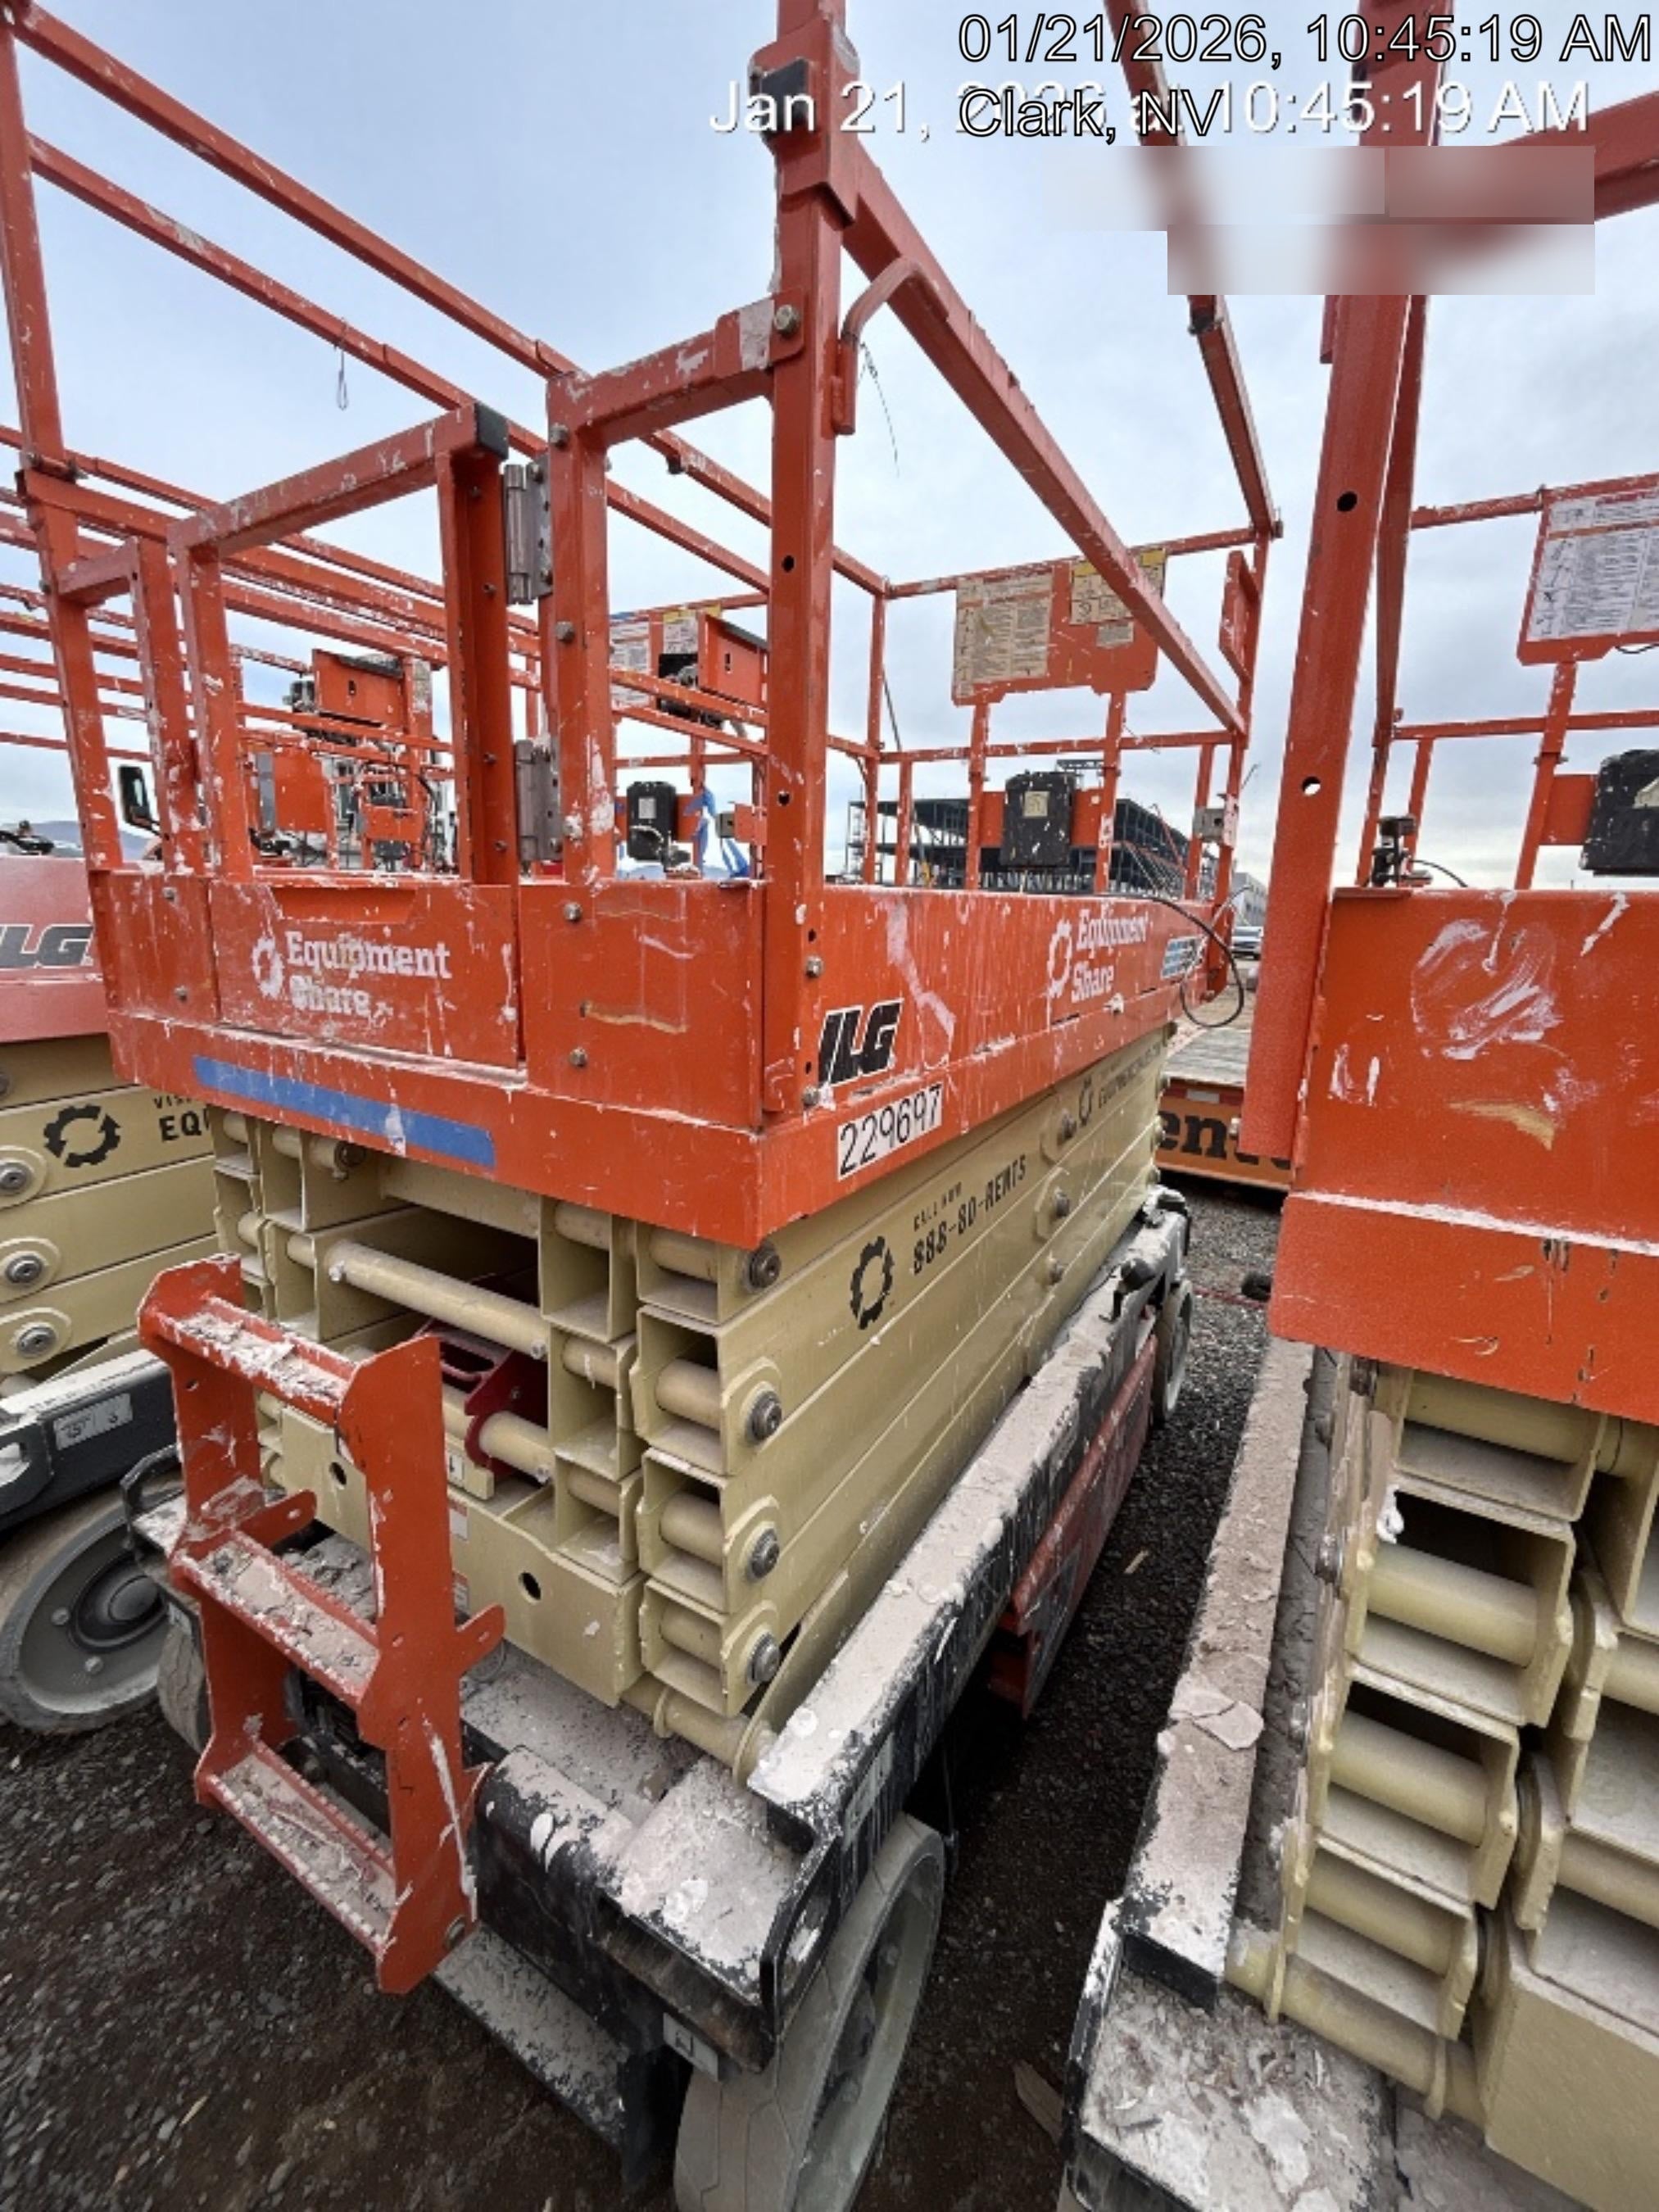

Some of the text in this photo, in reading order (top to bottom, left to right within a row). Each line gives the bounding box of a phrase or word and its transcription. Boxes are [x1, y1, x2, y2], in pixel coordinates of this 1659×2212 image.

[0, 923, 93, 970] LG
[285, 931, 452, 979] Equipment
[818, 998, 904, 1089] JLG
[840, 1082, 942, 1176] 229697
